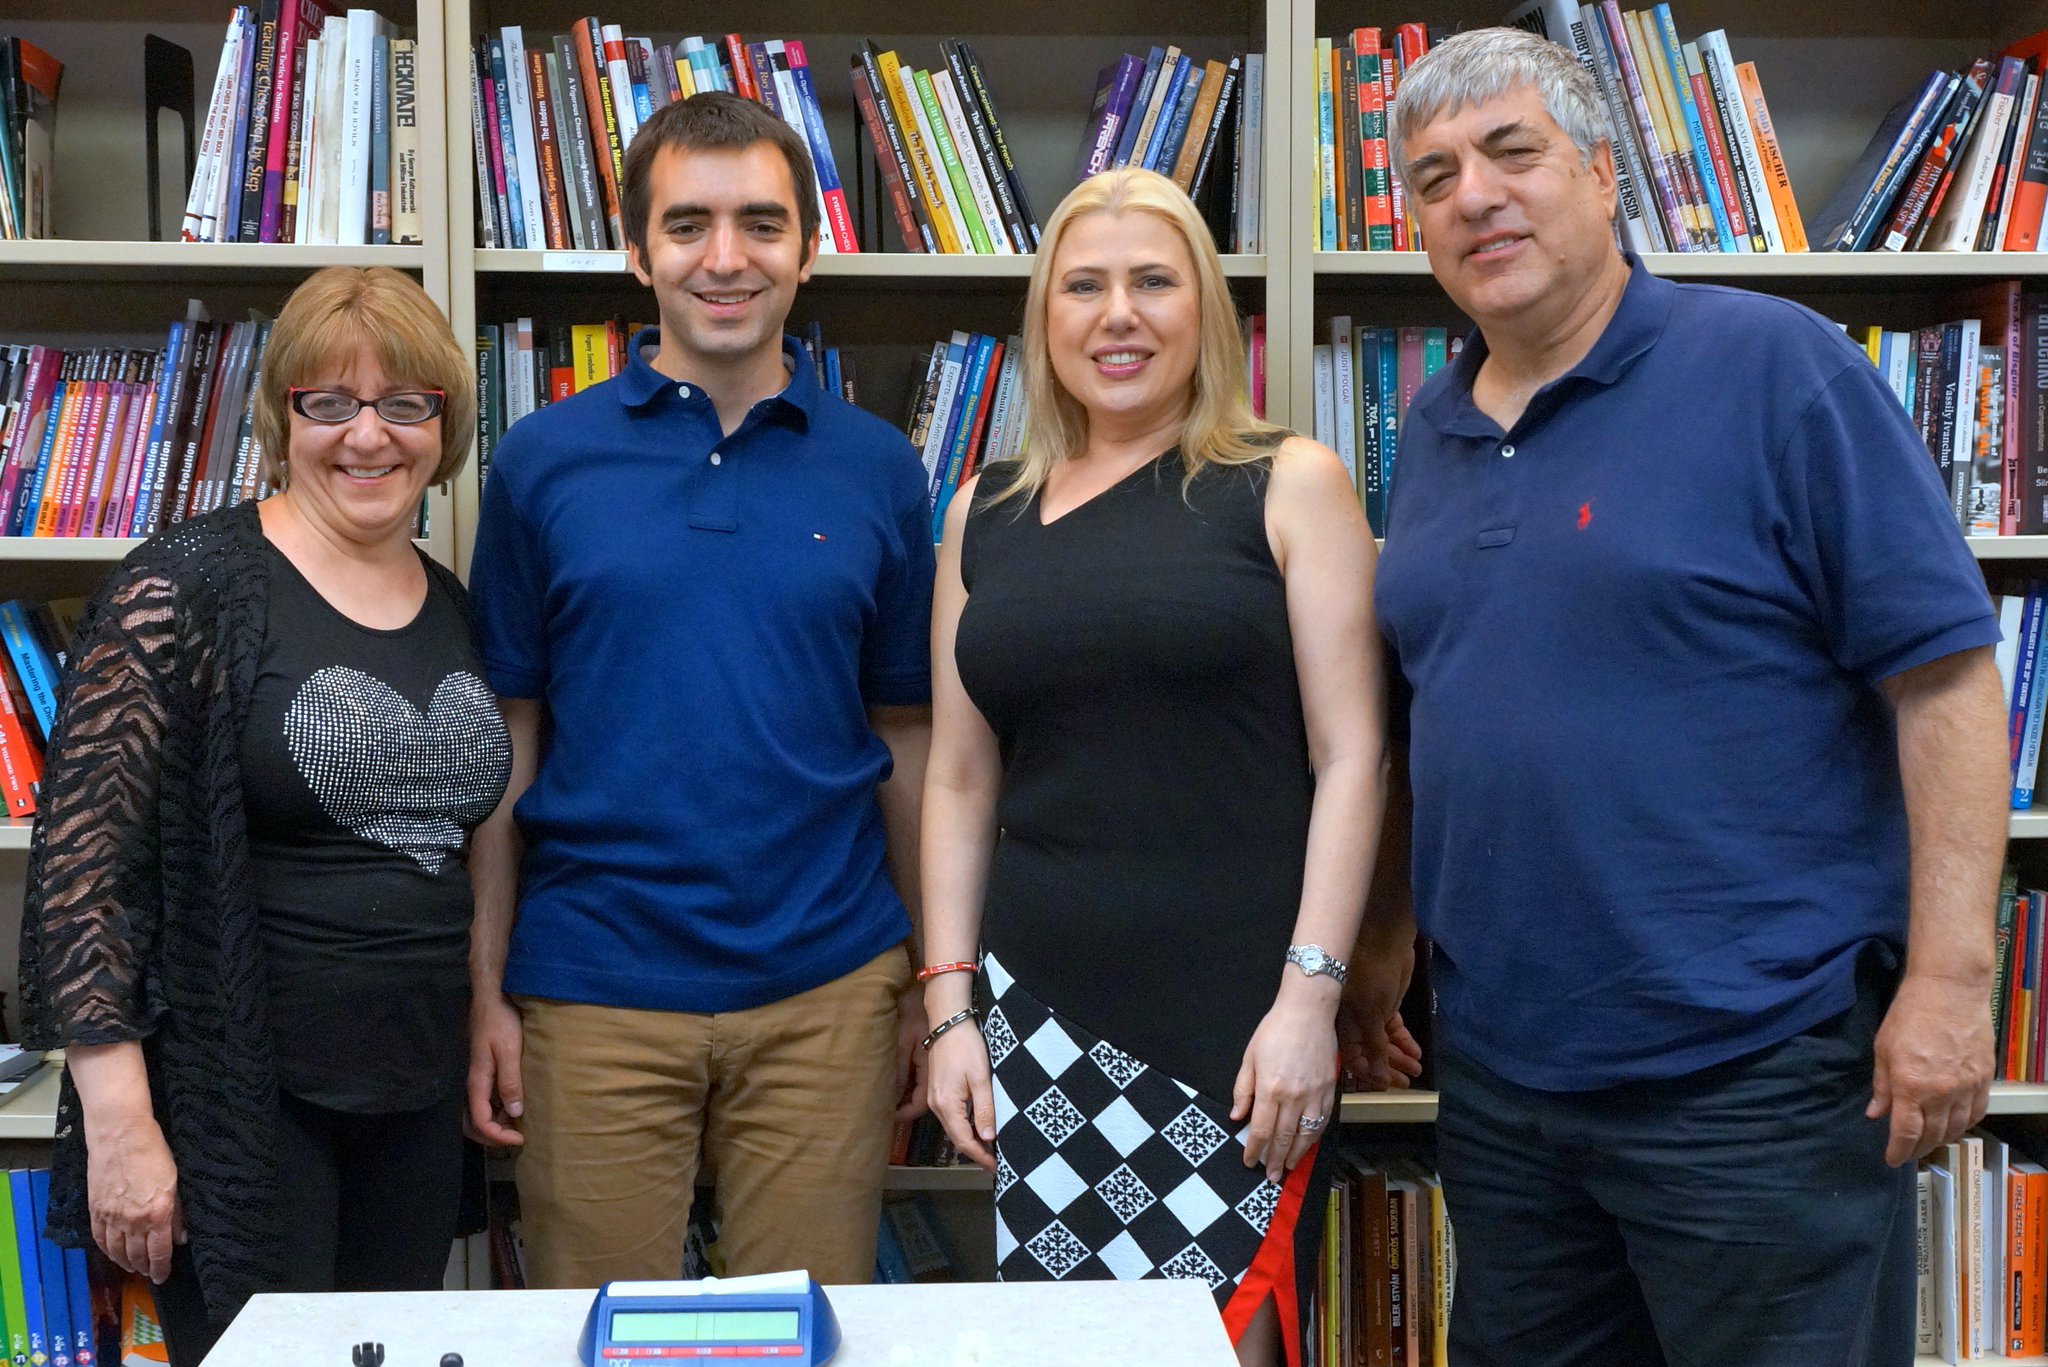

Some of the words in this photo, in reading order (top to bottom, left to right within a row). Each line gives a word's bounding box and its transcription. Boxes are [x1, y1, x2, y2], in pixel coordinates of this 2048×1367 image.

[255, 18, 276, 71] Teaching
[279, 31, 289, 52] Chess
[1570, 21, 1592, 56] BOBBY
[277, 53, 286, 78] Tactics
[532, 53, 542, 74] Game
[1165, 55, 1178, 66] 15
[1382, 58, 1392, 74] Bill
[255, 75, 271, 111] Chess
[276, 79, 284, 91] for
[535, 75, 545, 97] Vienna
[1220, 73, 1235, 99] French
[1369, 69, 1381, 94] The
[1383, 75, 1393, 97] Hook
[272, 92, 283, 123] Students
[537, 99, 548, 126] Modern
[568, 84, 580, 115] Vigorous
[598, 75, 616, 133] Understanding
[609, 134, 618, 147] the
[1993, 95, 2008, 127] Fischer
[249, 115, 267, 142] Step
[472, 95, 480, 129] KNIGHTS
[476, 131, 484, 166] DEFENCE
[574, 115, 583, 138] Chess
[970, 110, 981, 125] The
[1371, 97, 1384, 134] Chess
[1691, 119, 1704, 142] MIKE
[1715, 89, 1723, 100] OF
[1720, 108, 1732, 134] CHESS
[1726, 133, 1741, 166] MASTER
[541, 127, 550, 140] The
[878, 98, 891, 122] French:
[886, 122, 901, 150] Advance
[895, 149, 905, 163] and
[900, 162, 912, 180] Other
[906, 180, 918, 198] Lines
[975, 124, 991, 152] French:
[1087, 115, 1114, 175] FRENCH
[1135, 137, 1147, 154] Berg
[1728, 91, 1744, 125] CHESS
[1737, 125, 1763, 194] EXPLORATIONS
[247, 145, 265, 161] by
[576, 138, 588, 168] Opening
[993, 128, 1004, 144] The
[999, 144, 1015, 170] French
[1766, 138, 1788, 188] FISCHER
[244, 164, 263, 191] Step
[984, 151, 1002, 183] Tarrasch
[1372, 137, 1389, 208] Companion
[1697, 143, 1717, 186] DARLOW
[995, 182, 1013, 215] Variation
[1391, 188, 1404, 219] Memoir
[830, 195, 846, 231] EVERYMAN
[840, 231, 852, 251] CHESS
[2012, 335, 2019, 348] of
[479, 351, 488, 375] Chess
[1340, 350, 1348, 371] JUDIT
[2010, 350, 2019, 399] Bisguier
[27, 361, 40, 391] SECRETS
[942, 365, 957, 396] Experts
[1320, 372, 1329, 395] Polgar
[1340, 373, 1349, 405] POLGAR
[24, 390, 33, 401] OF
[106, 394, 119, 423] SECRETS
[478, 377, 488, 418] Openings
[941, 396, 948, 405] on
[1941, 381, 1956, 419] Vassily
[18, 401, 30, 429] OPENING
[104, 423, 113, 432] OF
[480, 420, 488, 433] for
[937, 408, 946, 420] the
[1369, 403, 1378, 426] TAL
[1385, 417, 1396, 430] 2
[98, 431, 111, 461] OPENING
[992, 423, 1001, 439] The
[1938, 420, 1953, 469] Ivanchuk
[231, 435, 251, 486] Evolution
[479, 435, 488, 462] White,
[954, 441, 964, 455] the
[139, 440, 160, 492] Evolution
[152, 439, 173, 491] Evolution
[177, 441, 198, 492] Evolution
[946, 455, 961, 485] Sicilian
[190, 479, 205, 510] Evolution
[931, 477, 941, 497] Milos
[1956, 471, 1964, 505] EVERYMAN
[134, 491, 149, 524] Chess
[147, 491, 162, 523] Chess
[171, 492, 187, 524] Chess
[20, 651, 42, 691] Mastering
[36, 691, 47, 706] the
[8, 774, 18, 791] TWO
[1972, 1169, 1980, 1219] COMPRENDER
[1390, 1273, 1400, 1300] ISTVÁN
[1392, 1302, 1400, 1326] BILEK
